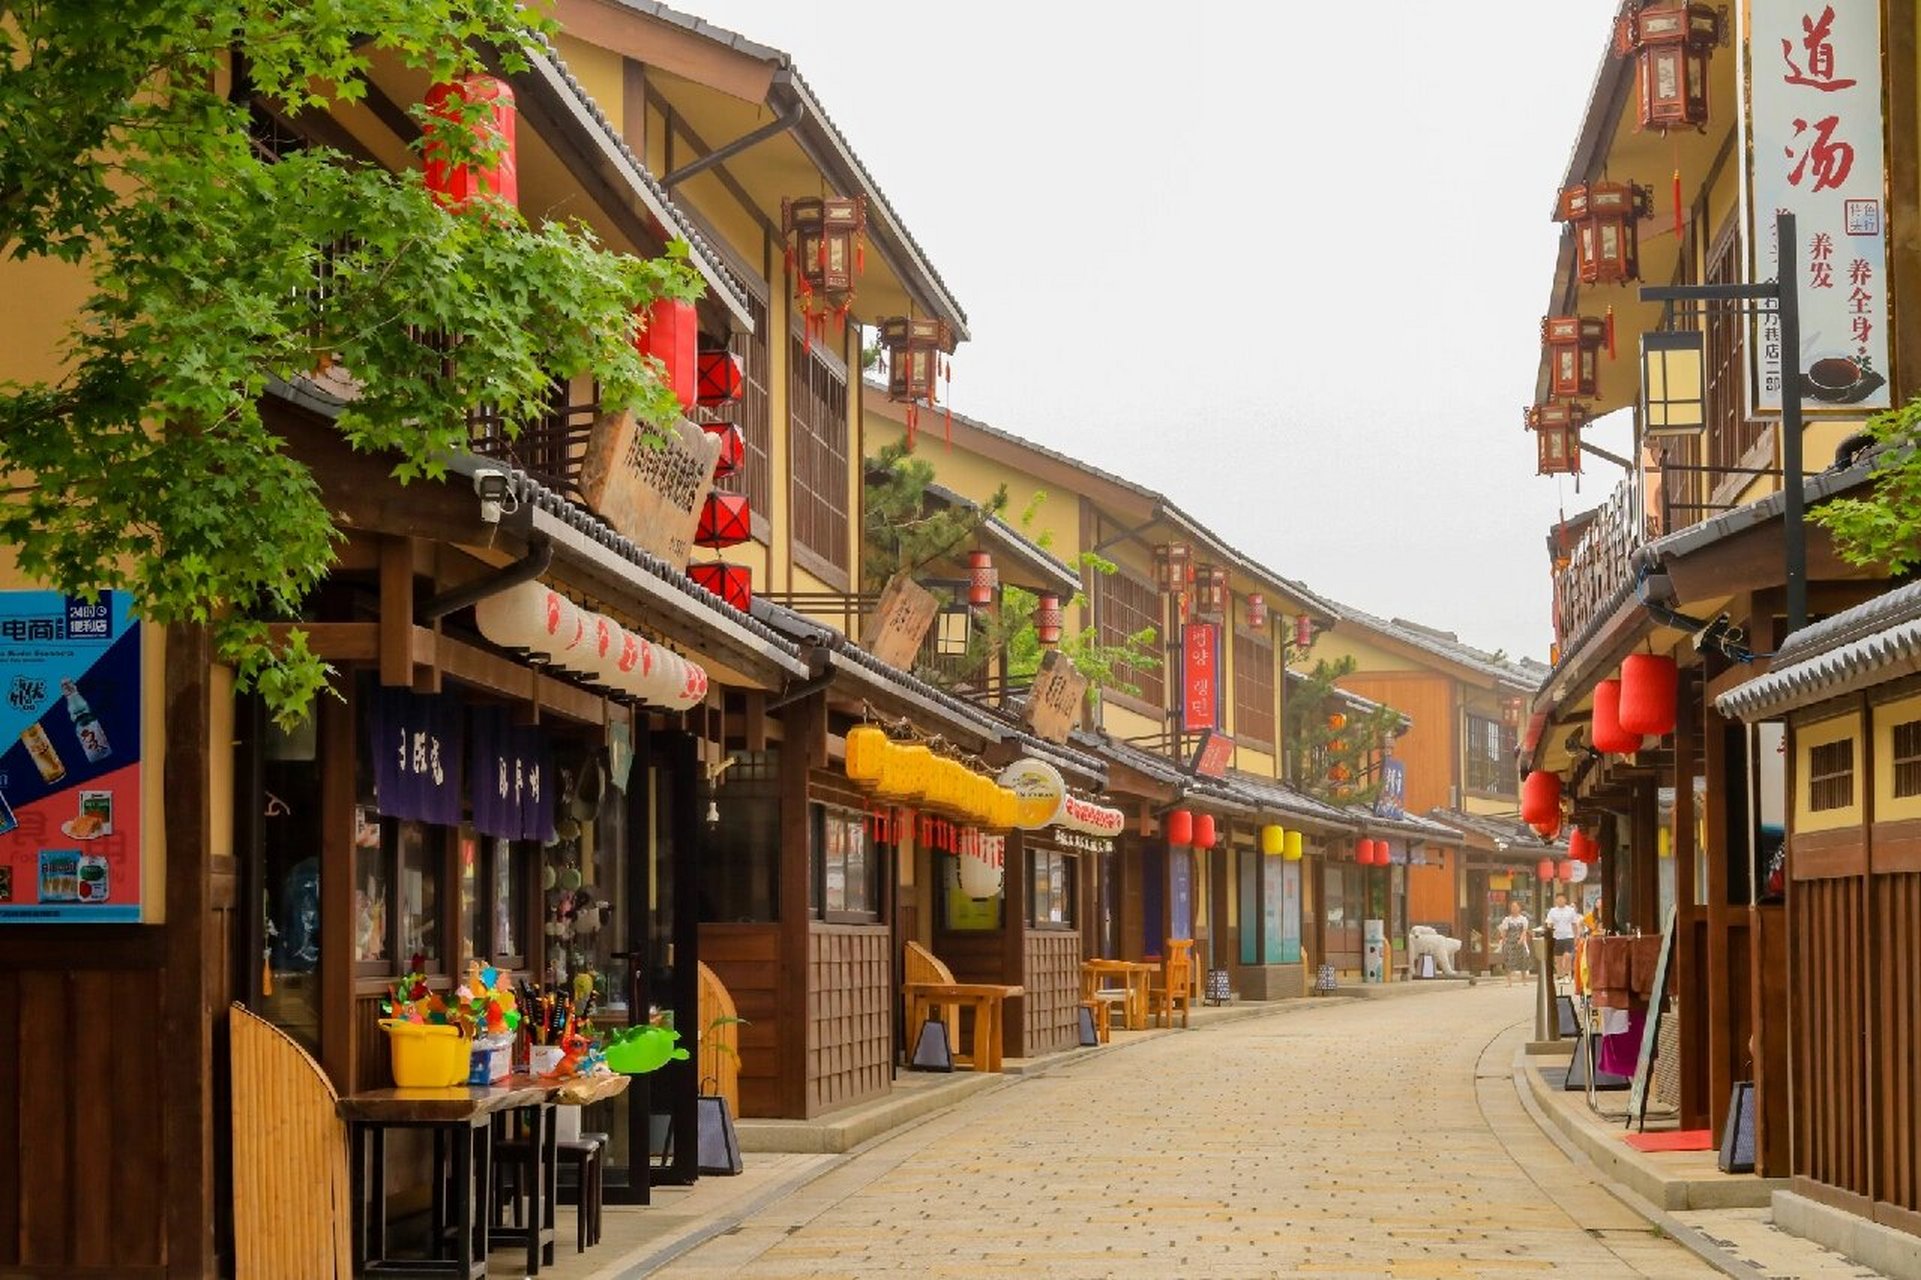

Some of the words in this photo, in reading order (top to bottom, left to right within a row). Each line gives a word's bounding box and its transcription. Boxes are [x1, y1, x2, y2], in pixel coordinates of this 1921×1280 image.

[1781, 5, 1857, 193] 道汤
[1809, 232, 1834, 289] 养发
[1847, 258, 1873, 343] 养全身
[3, 619, 55, 642] 电商
